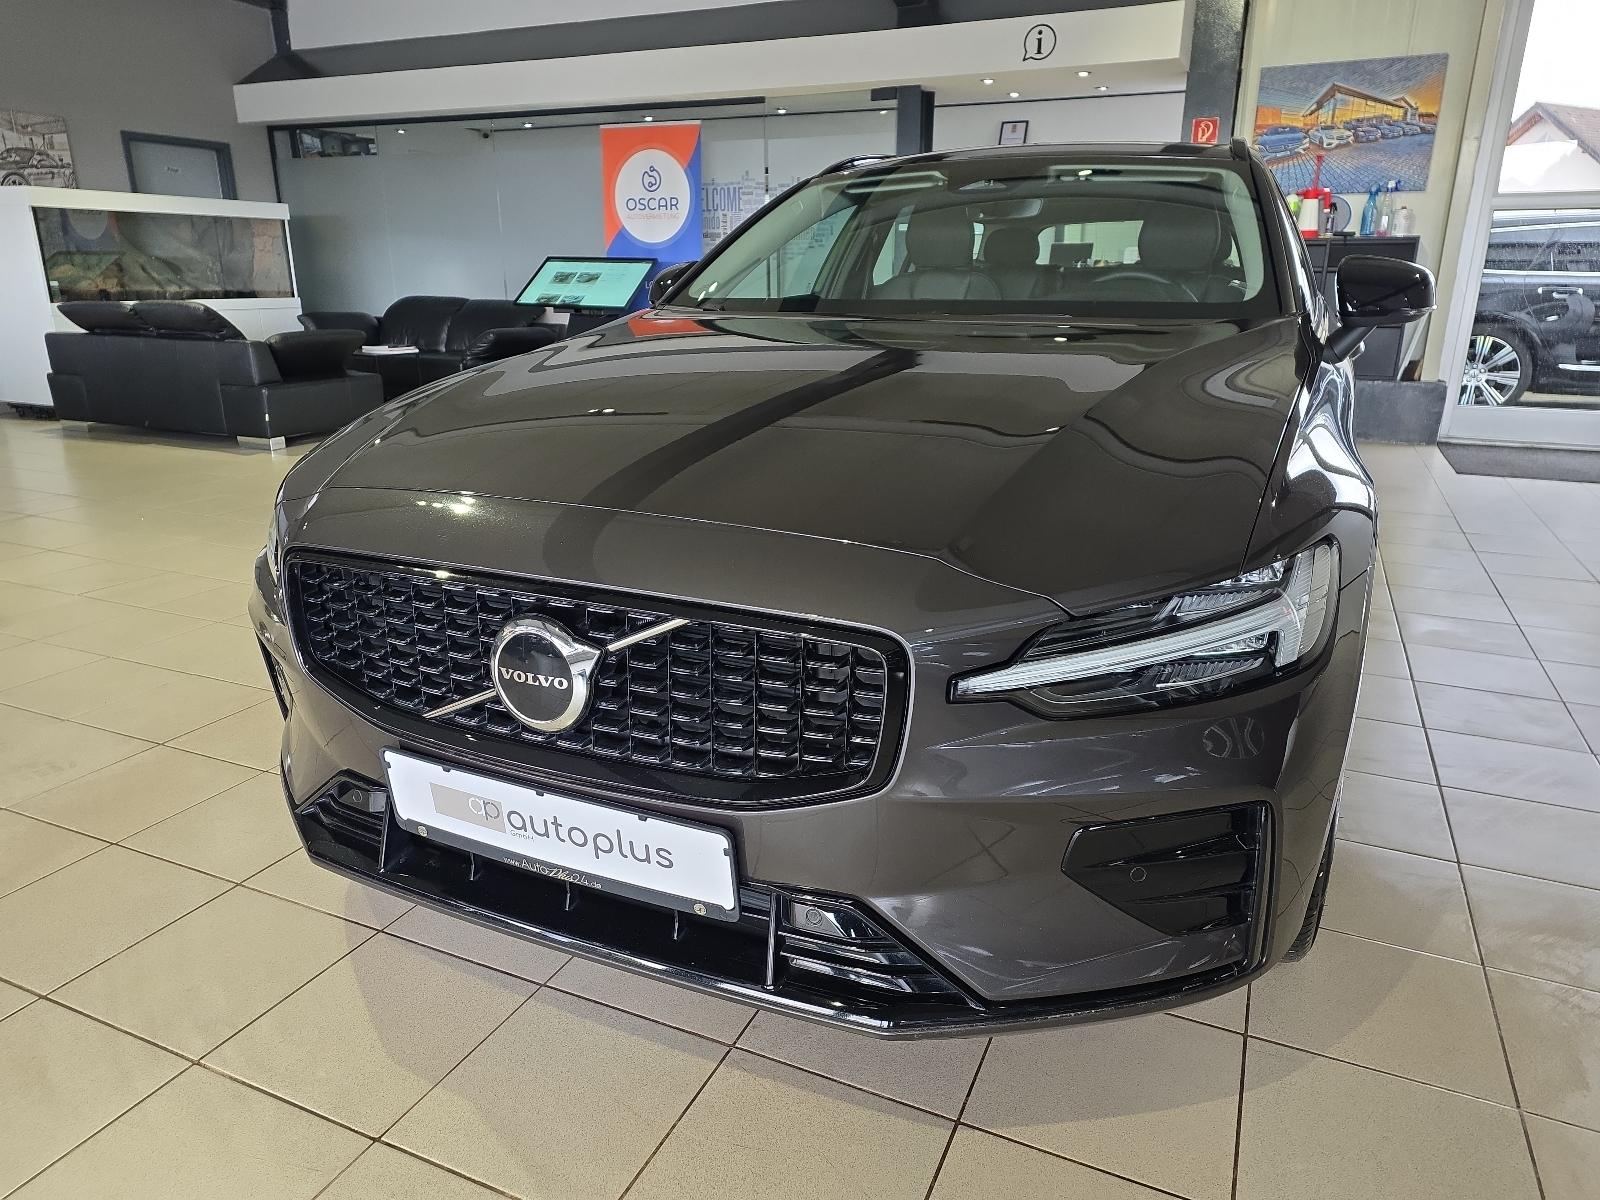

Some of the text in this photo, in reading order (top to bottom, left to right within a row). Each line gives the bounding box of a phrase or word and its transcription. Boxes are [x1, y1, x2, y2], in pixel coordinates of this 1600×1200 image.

[626, 196, 679, 211] OSCAR
[498, 666, 569, 690] VOLVO
[506, 809, 675, 869] autoplus
[510, 829, 535, 843] GmbH
